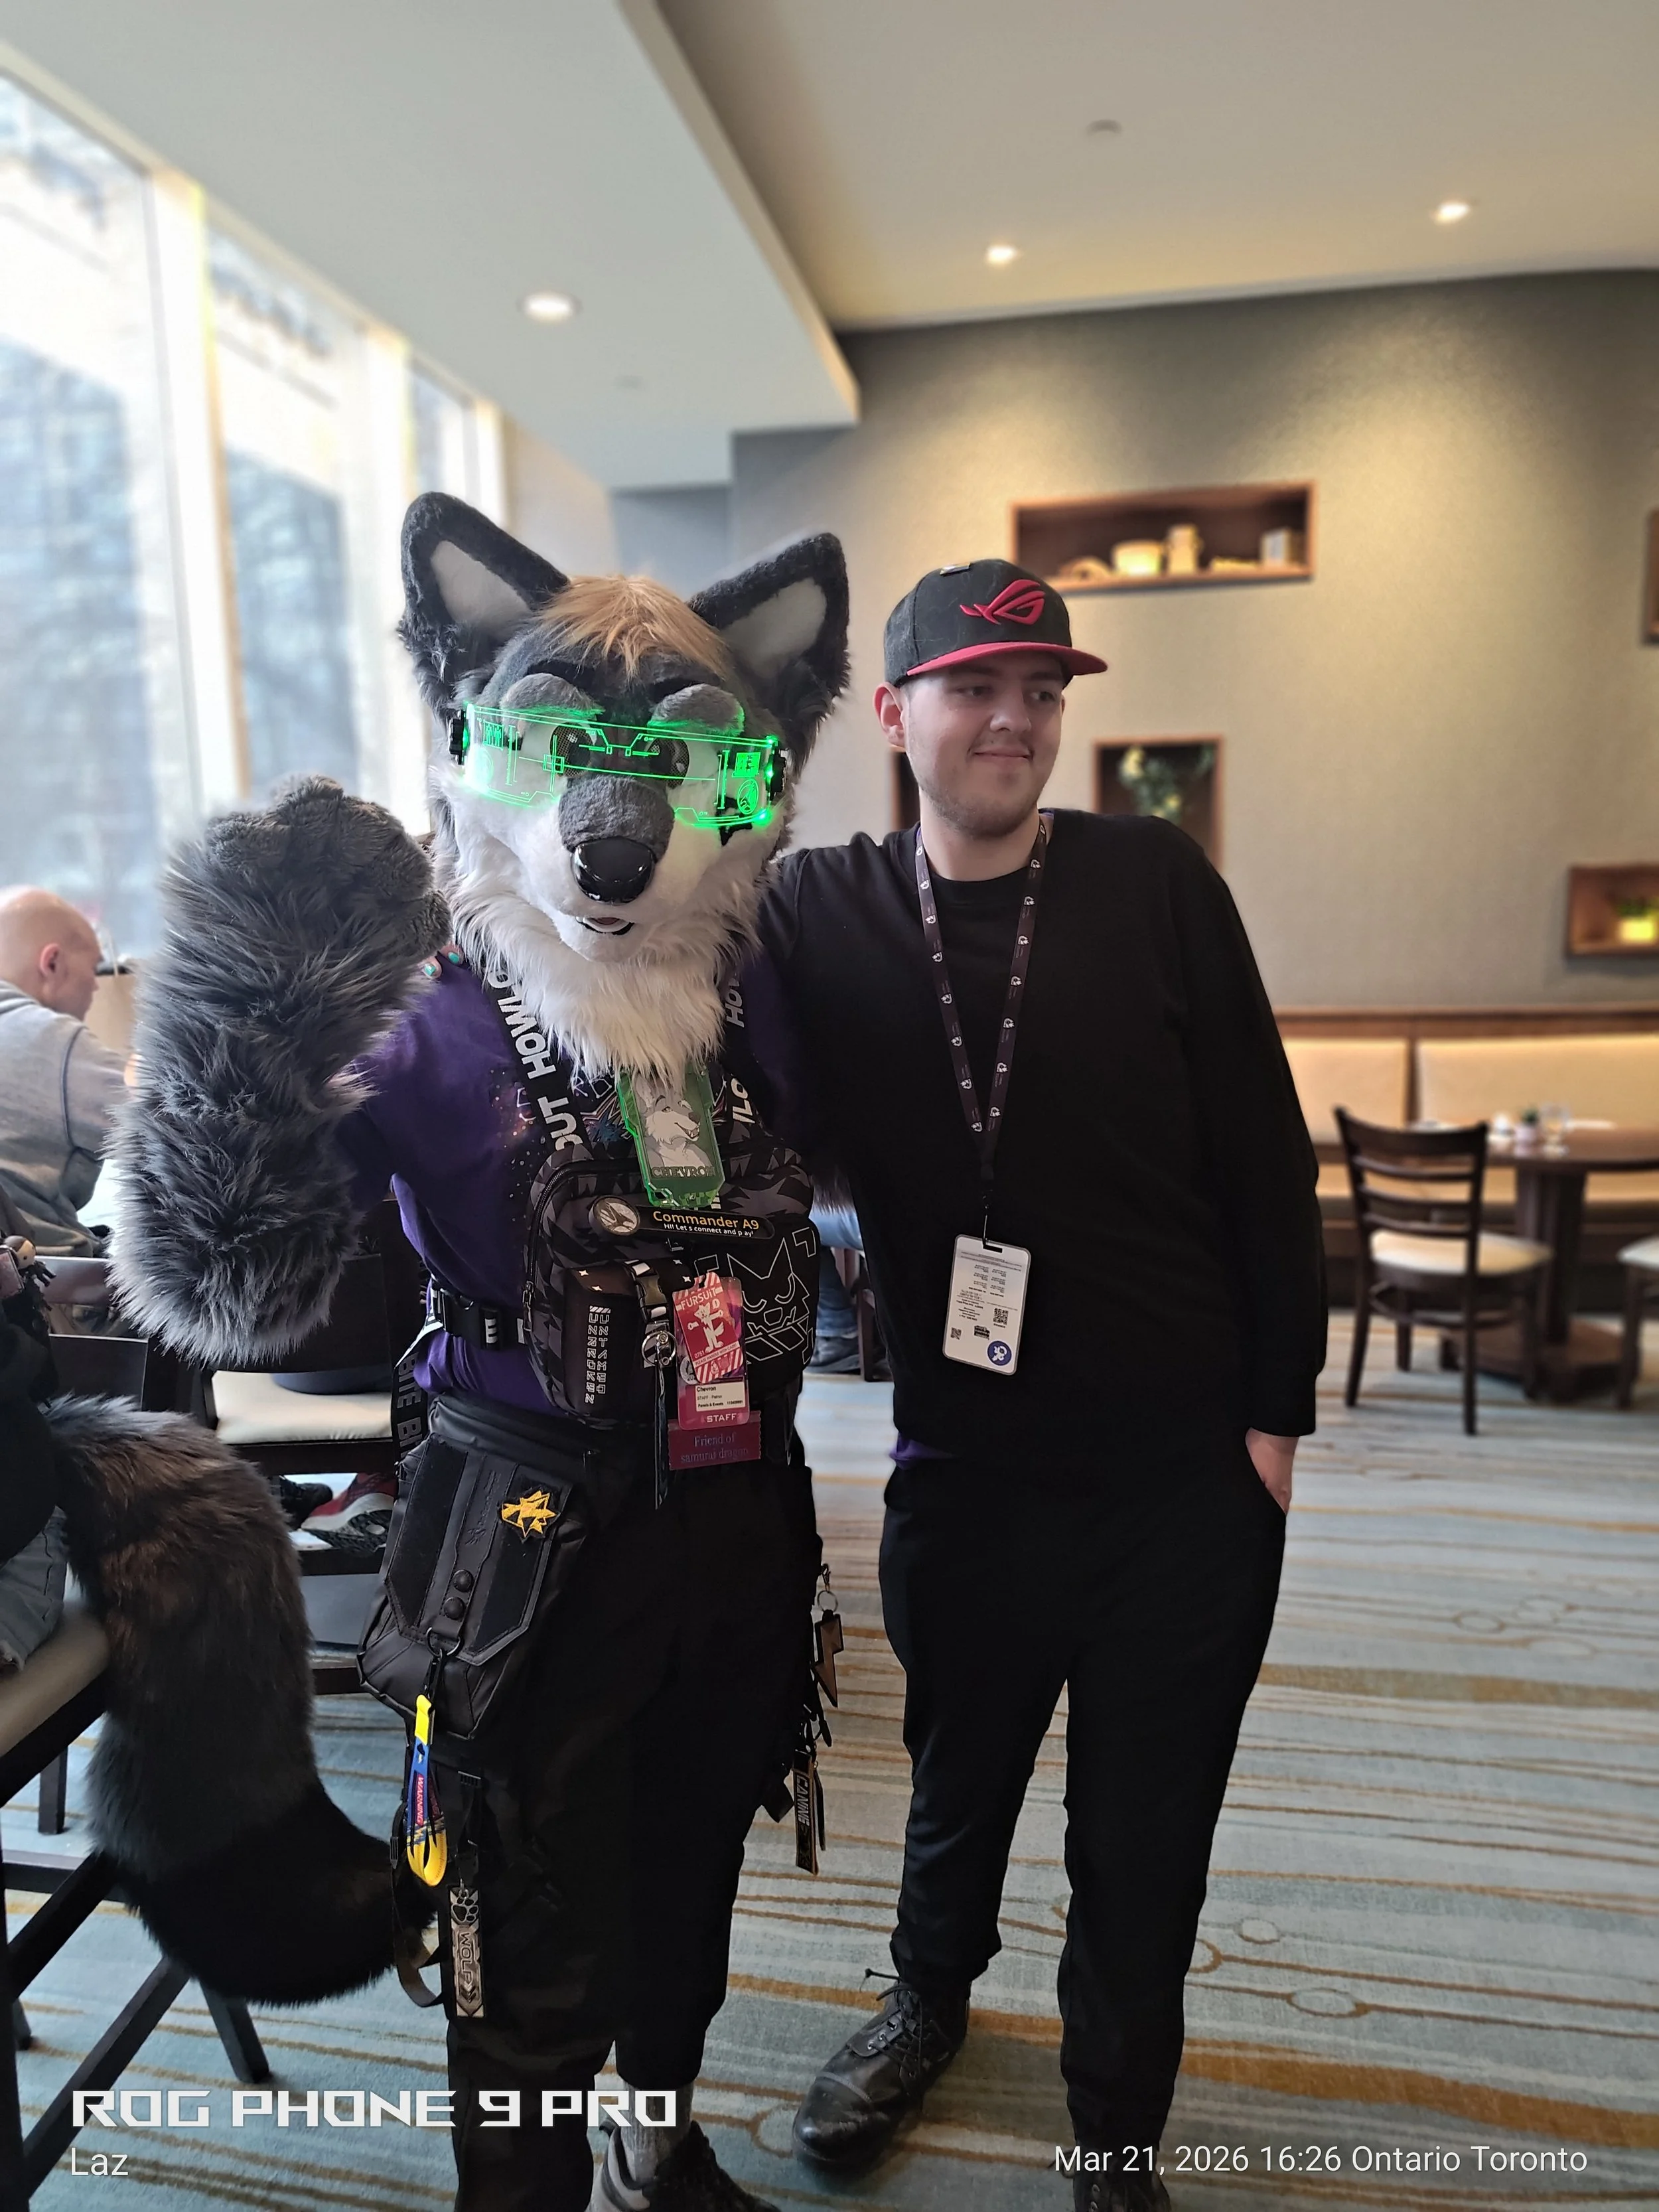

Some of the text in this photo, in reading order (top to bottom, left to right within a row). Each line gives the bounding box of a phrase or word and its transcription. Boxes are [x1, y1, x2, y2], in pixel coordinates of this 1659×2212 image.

[651, 1165, 716, 1179] CHEVRON
[653, 1211, 759, 1230] Commander A9
[694, 1225, 722, 1234] connect
[723, 1226, 736, 1235] and
[707, 1413, 737, 1423] STAFF
[694, 1432, 736, 1447] Friend of
[681, 1448, 716, 1463] samurai
[415, 1775, 424, 1824] WARNING
